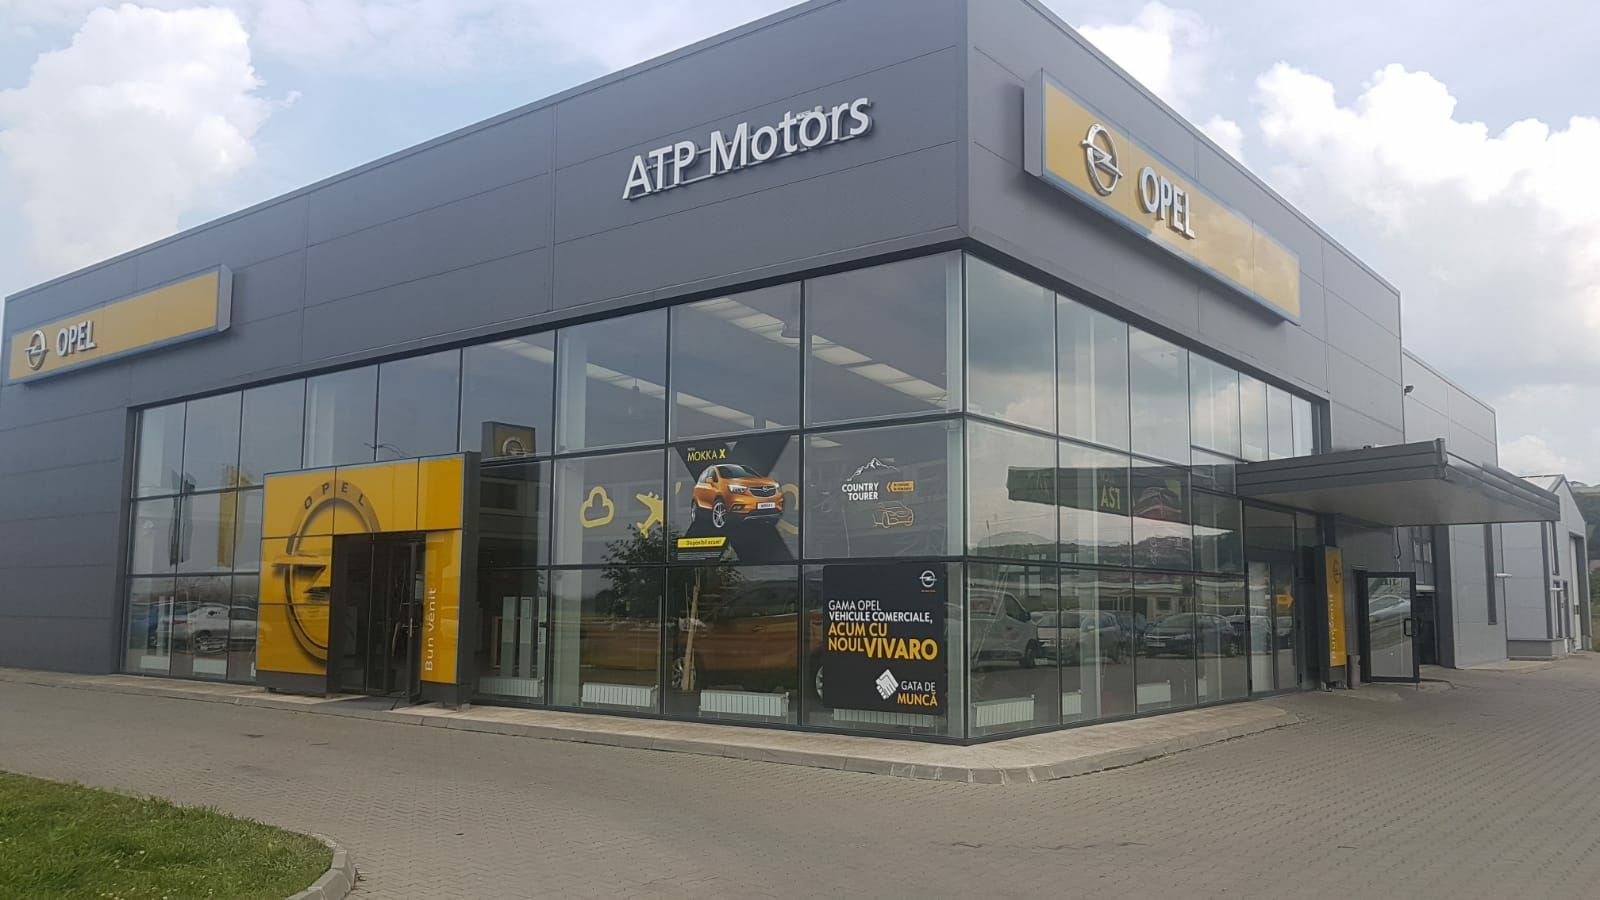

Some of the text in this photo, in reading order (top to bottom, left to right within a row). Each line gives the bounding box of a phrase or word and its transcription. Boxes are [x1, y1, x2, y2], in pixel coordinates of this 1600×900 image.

[622, 97, 873, 200] ATP Motors
[1138, 166, 1196, 240] OPEL
[56, 320, 97, 357] OPEL
[688, 448, 726, 462] MOKKA X
[841, 482, 879, 492] COUNTRY
[304, 481, 364, 510] OPEL
[848, 491, 878, 501] TOURER
[828, 600, 881, 611] GAMA OPEL
[829, 611, 933, 624] VEHICULE COMERCIALE,
[828, 622, 888, 637] ACUM CU
[424, 636, 435, 671] Bun
[828, 637, 938, 660] NOUL VIVARO
[901, 681, 936, 692] GATA DE
[897, 692, 938, 706] MUNCĂ
